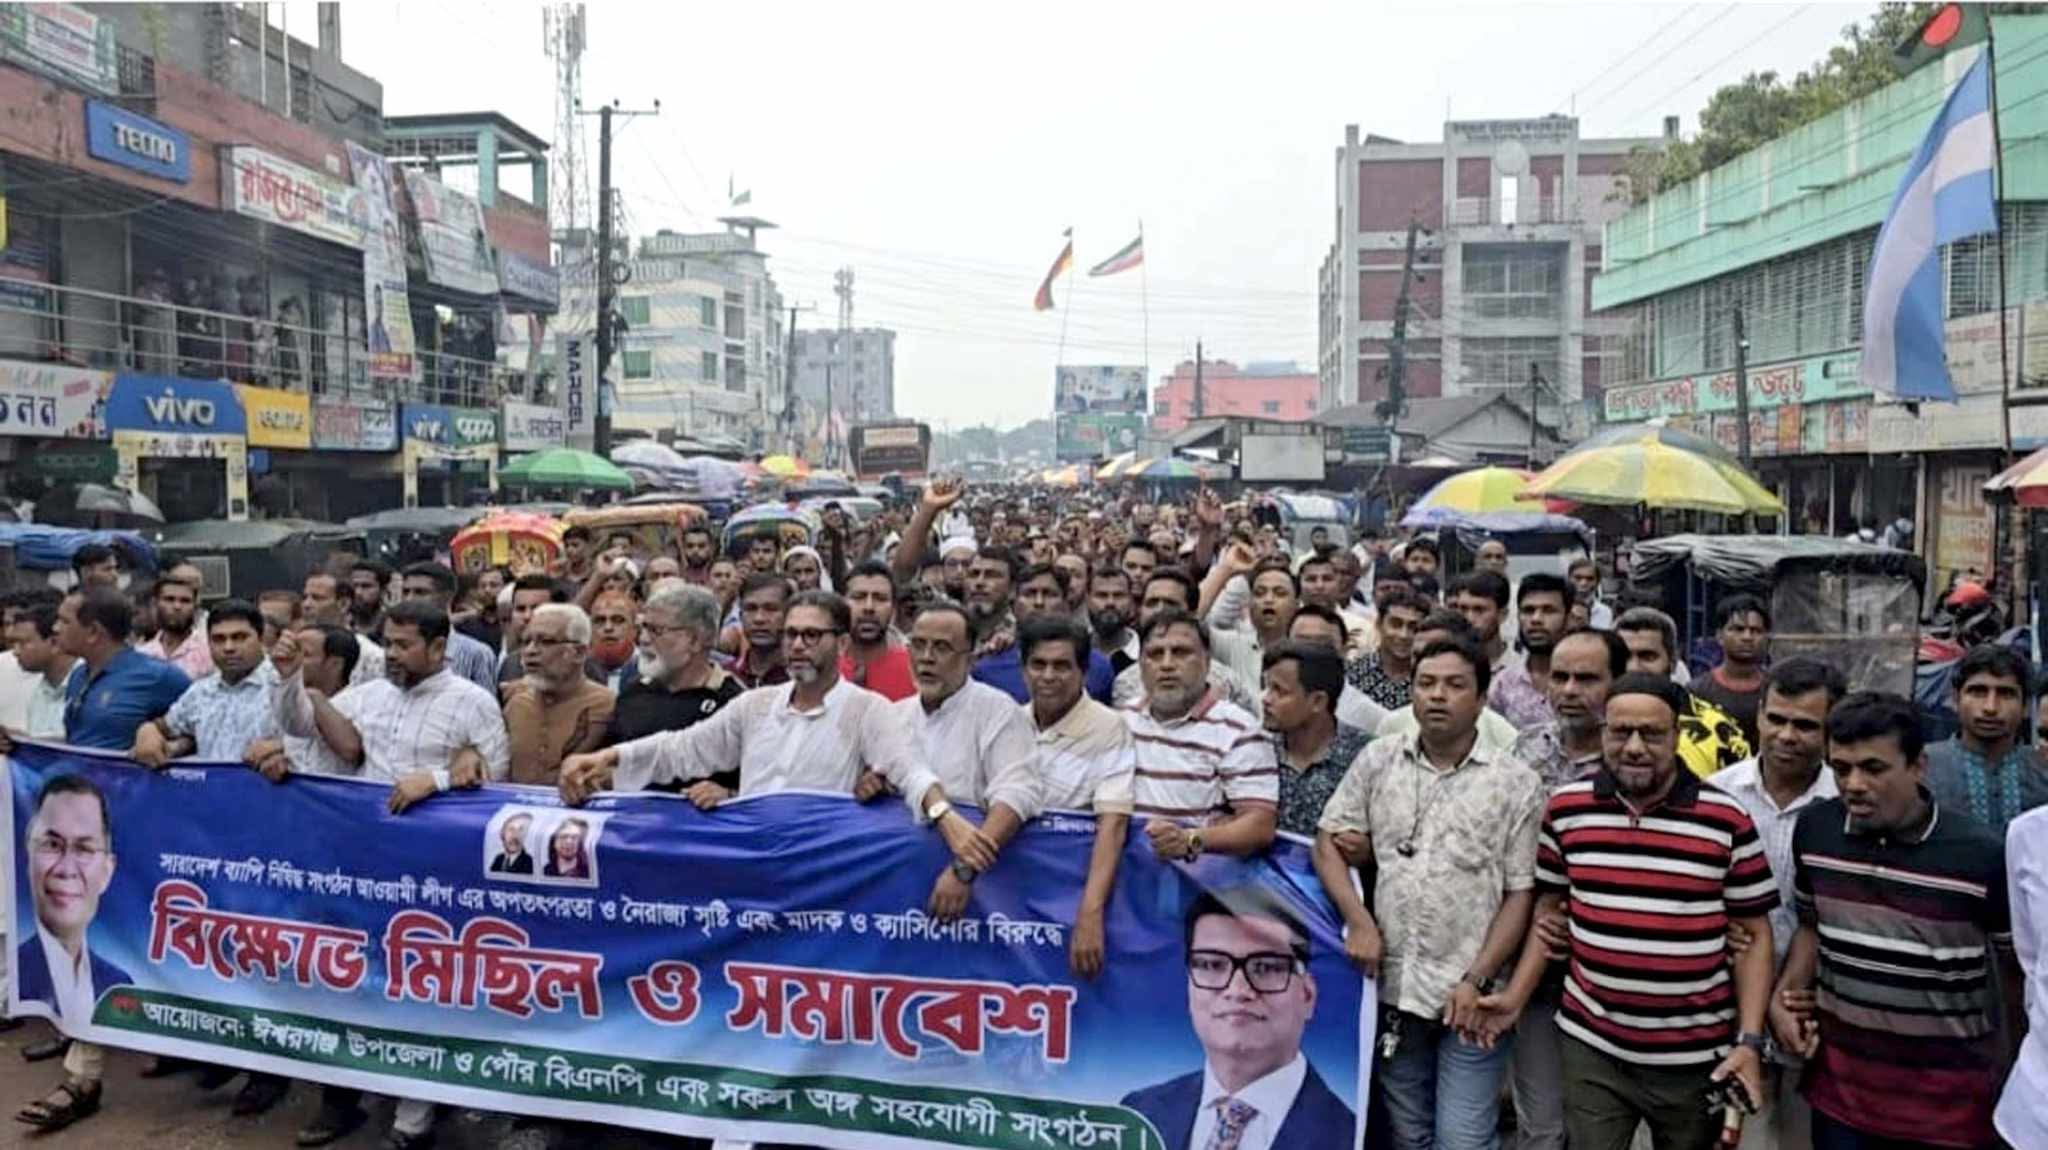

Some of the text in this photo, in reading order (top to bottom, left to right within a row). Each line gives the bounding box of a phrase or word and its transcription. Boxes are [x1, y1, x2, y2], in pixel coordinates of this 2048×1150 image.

[145, 386, 216, 424] vivo
[566, 340, 584, 431] MARCEL
[160, 852, 221, 880] সারাদেশ
[223, 857, 266, 885] ব্যাপি
[267, 862, 304, 891] নিষিদ্ধ
[307, 867, 352, 897] সংগঠন
[356, 869, 416, 904] আওয়ামী
[422, 877, 453, 906] লীগ
[458, 887, 485, 909] এর
[601, 901, 616, 921] ও
[622, 894, 688, 928] নৈরাজ্য
[693, 898, 731, 939] সৃষ্টি
[737, 912, 780, 934] এবং
[852, 914, 868, 934] ও
[987, 911, 1064, 947] বিরুদ্ধে
[151, 882, 1076, 1060] বিক্ষোভ মিছিল ও সমাবেশ
[252, 1013, 340, 1058] ঈশ্বরগঞ্জ
[347, 1027, 446, 1072] উপজেলা
[455, 1046, 473, 1072] ও
[480, 1050, 535, 1086] পৌর
[545, 1056, 645, 1098] বিএনপি
[656, 1078, 710, 1108] এবং
[717, 1081, 795, 1111] সকল
[803, 1087, 863, 1121] অঙ্গ
[871, 1096, 1002, 1136] সহযোগী
[1011, 1108, 1128, 1149] সংগঠন
